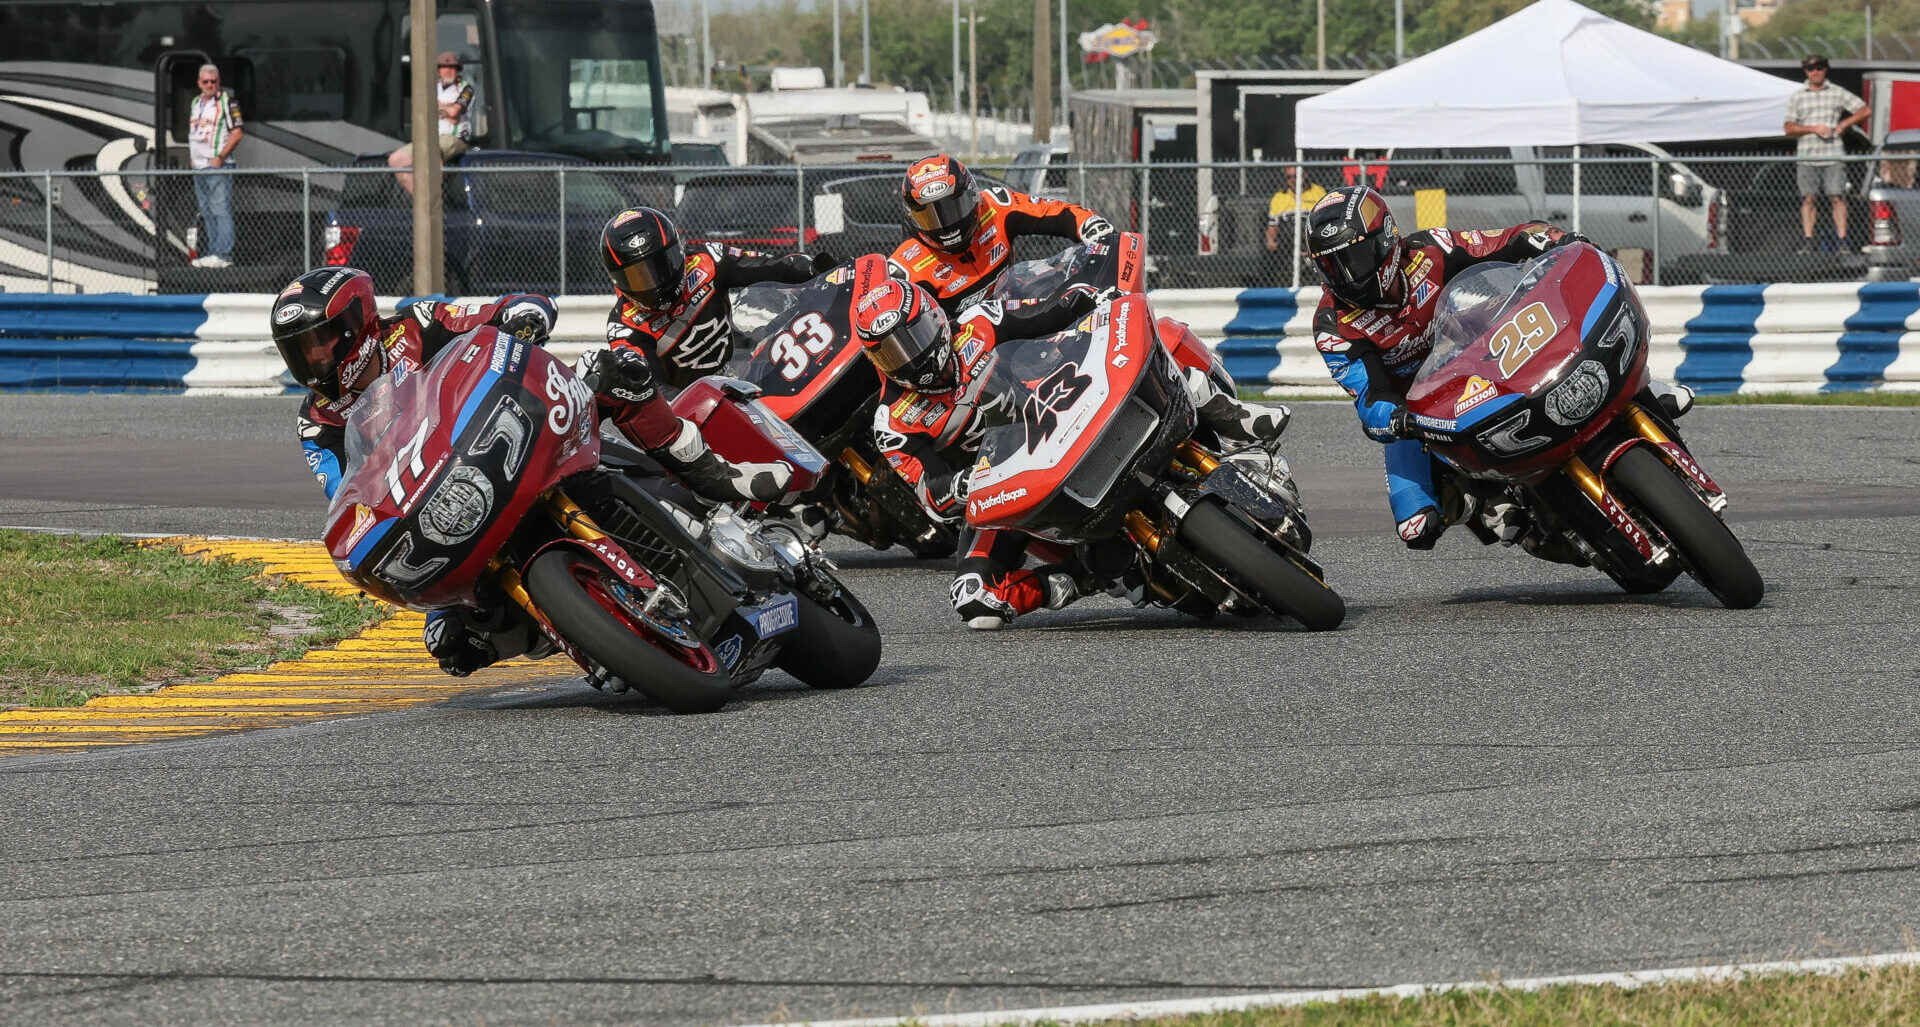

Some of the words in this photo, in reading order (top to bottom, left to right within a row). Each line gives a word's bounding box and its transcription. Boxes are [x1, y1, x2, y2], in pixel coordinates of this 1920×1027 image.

[925, 182, 944, 195] Arai
[388, 337, 410, 362] TROY
[770, 311, 835, 381] 33
[1490, 302, 1557, 379] 29
[1456, 386, 1496, 414] MISSION
[1416, 415, 1457, 430] PROGRESSIVE
[385, 416, 430, 506] 17
